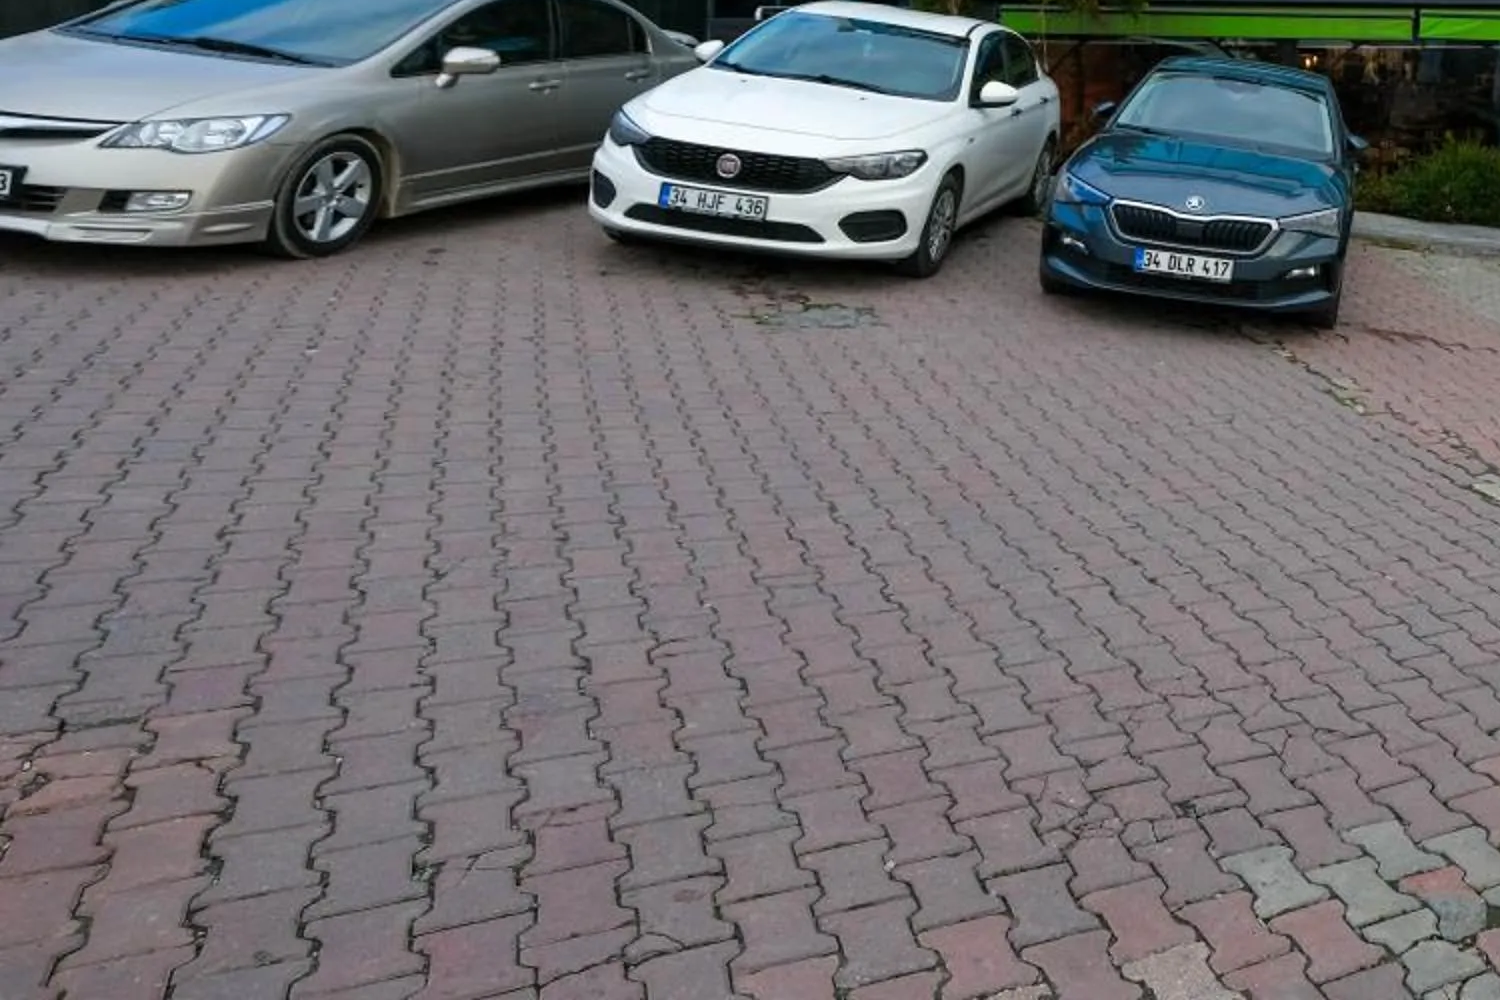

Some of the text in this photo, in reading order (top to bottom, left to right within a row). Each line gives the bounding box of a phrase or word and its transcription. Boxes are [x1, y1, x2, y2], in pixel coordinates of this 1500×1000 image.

[671, 188, 763, 215] 34 HJF 436
[1144, 251, 1230, 277] 34 DLR 417
